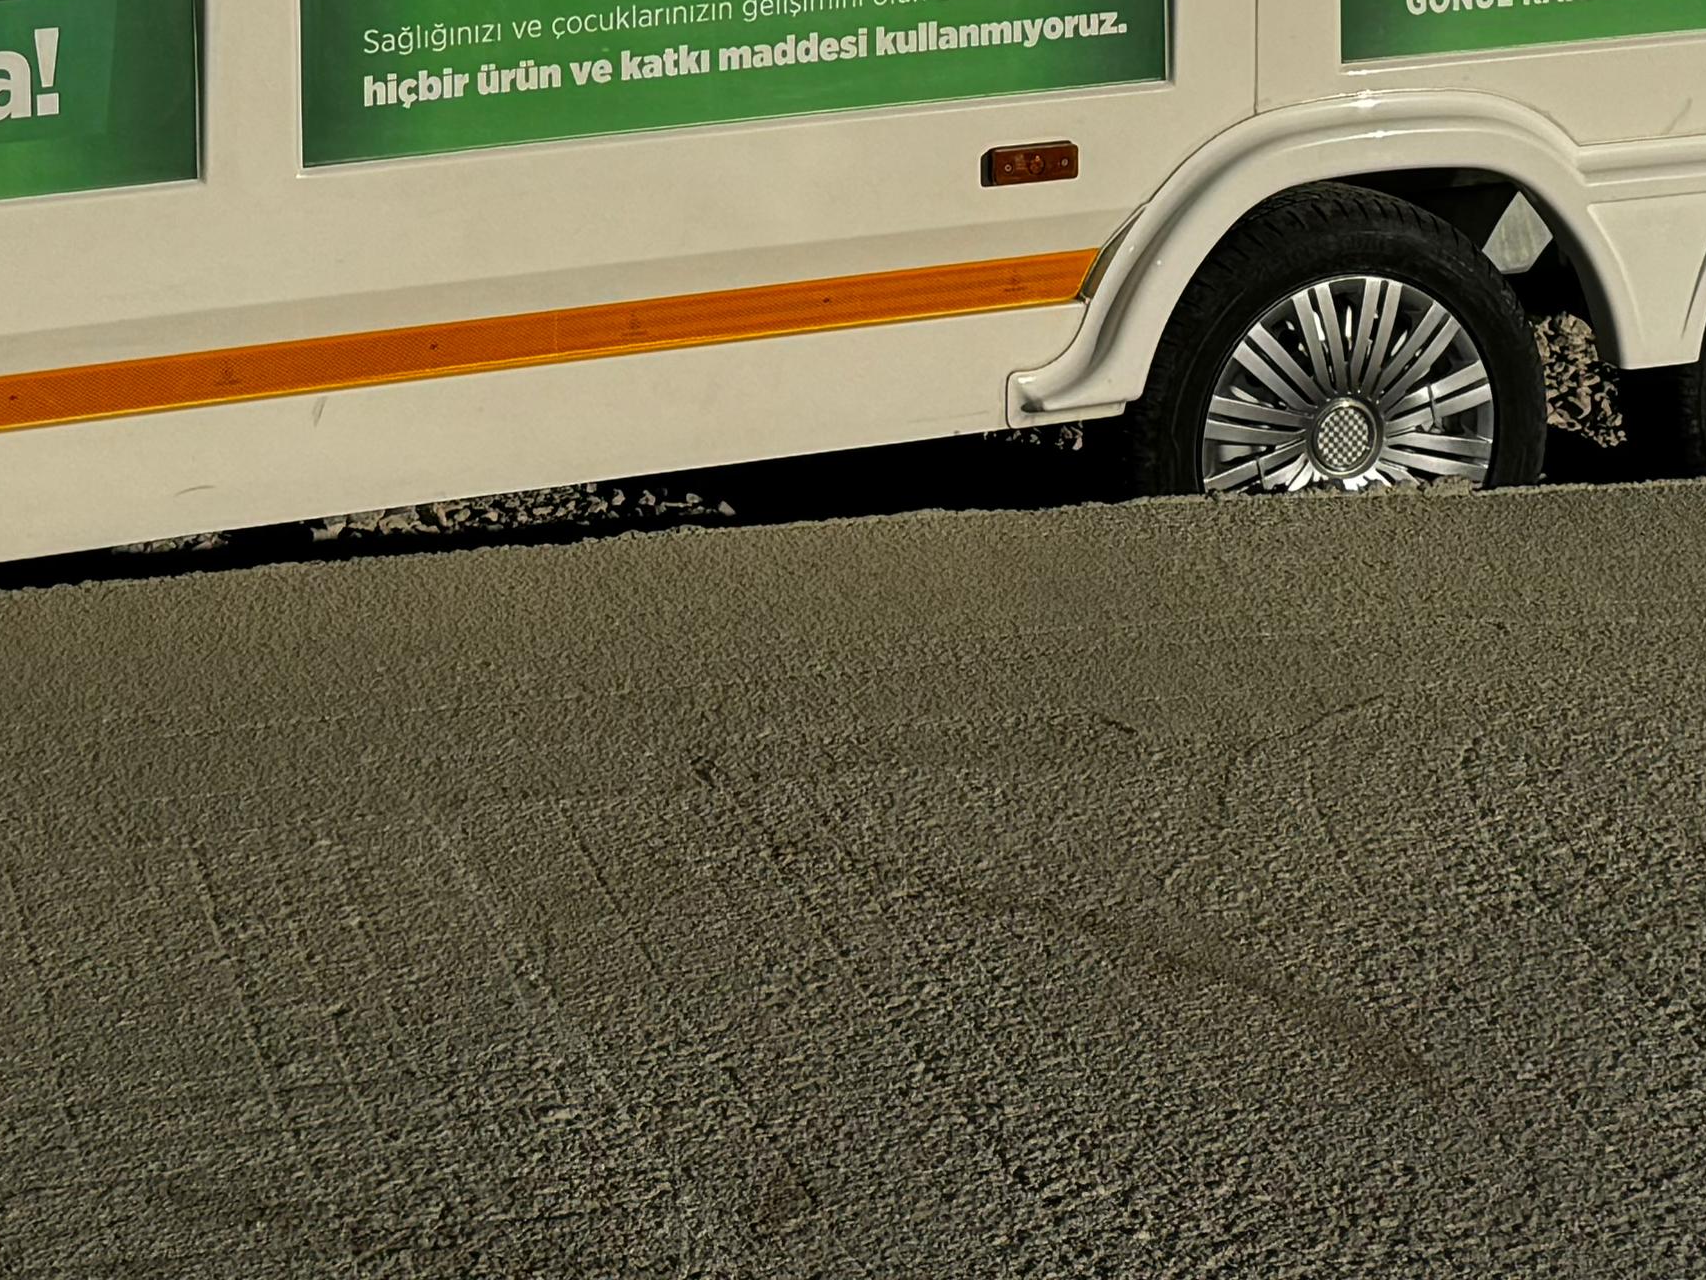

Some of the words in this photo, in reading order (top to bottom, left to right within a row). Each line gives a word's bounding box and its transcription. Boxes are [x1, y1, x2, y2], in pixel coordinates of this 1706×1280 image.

[363, 22, 502, 56] Sağlığınızı
[512, 19, 543, 40] ve
[551, 0, 733, 40] çocuklarınızın
[363, 66, 470, 109] hiçbir
[476, 58, 562, 96] ürün
[569, 57, 614, 86] ve
[620, 44, 711, 81] katkı
[718, 28, 869, 72] maddesi
[875, 10, 1129, 57] kullanmıyoruz.
